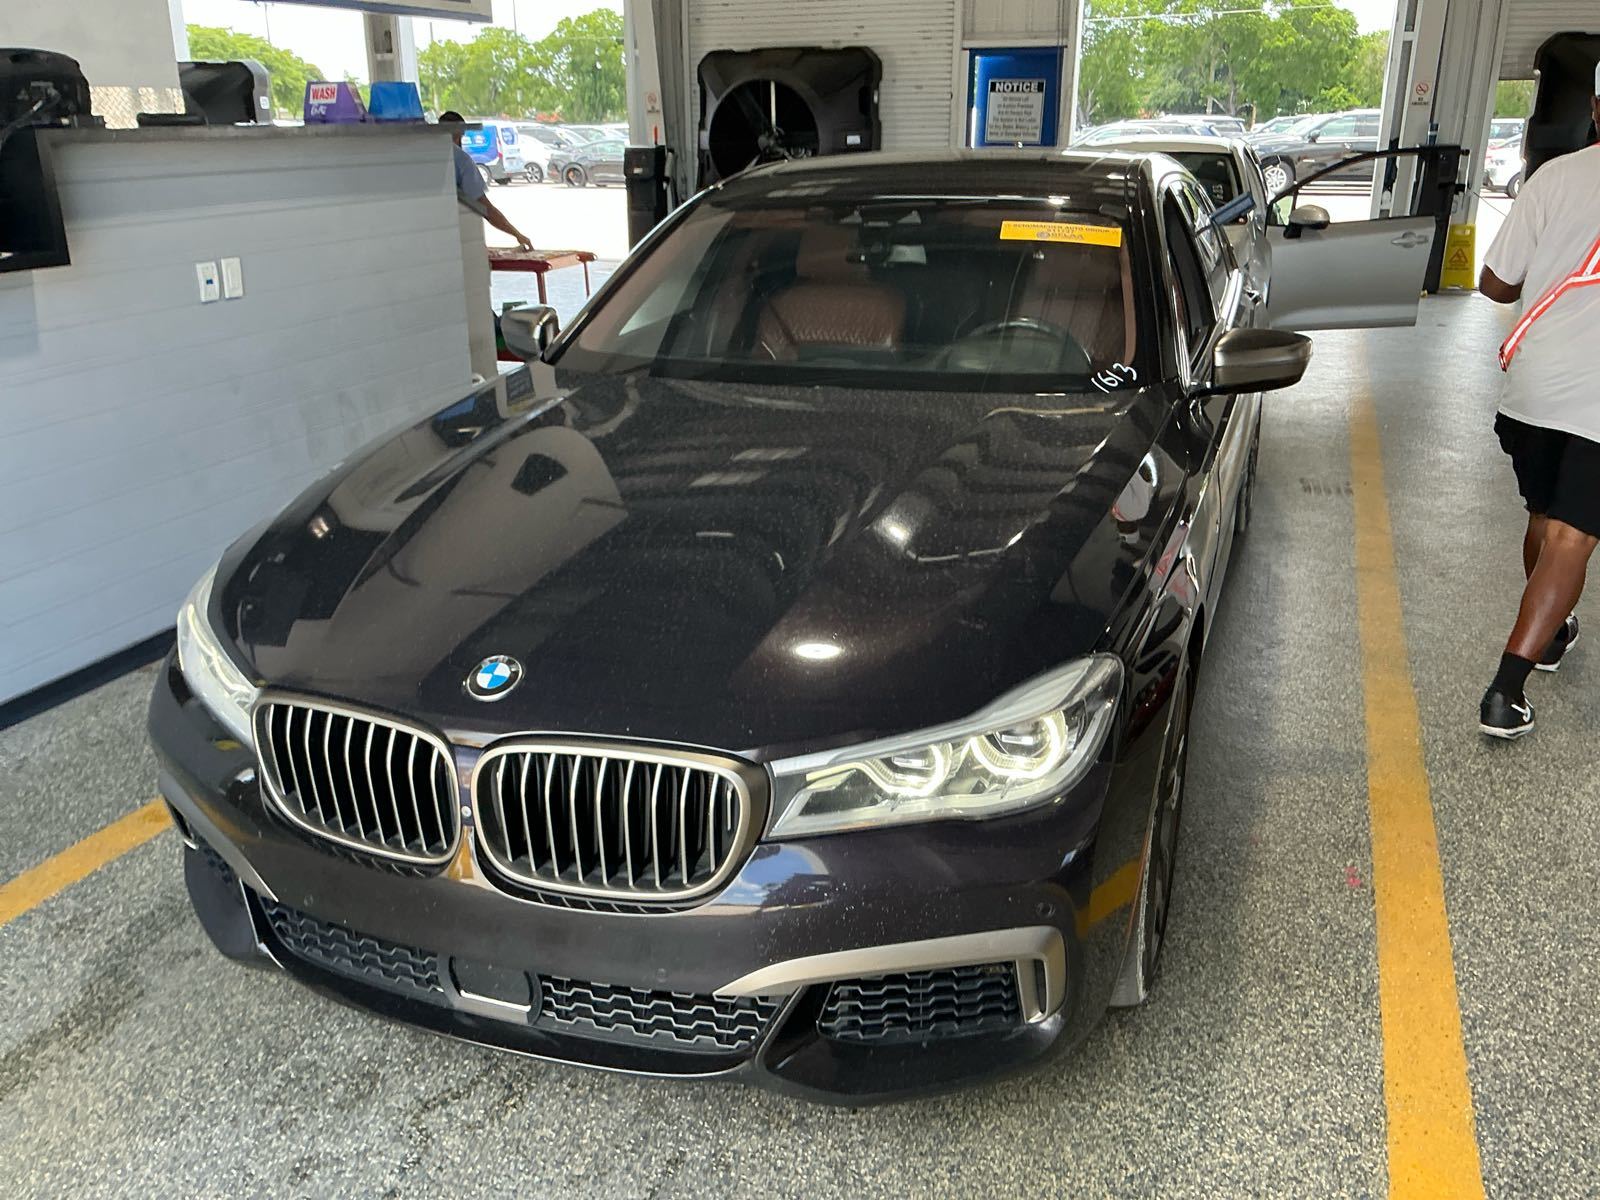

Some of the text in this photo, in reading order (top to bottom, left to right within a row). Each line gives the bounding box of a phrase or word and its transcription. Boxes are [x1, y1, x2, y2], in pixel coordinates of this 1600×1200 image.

[312, 87, 336, 100] WASH
[995, 82, 1038, 92] NOTICE
[1091, 362, 1138, 394] 1613
